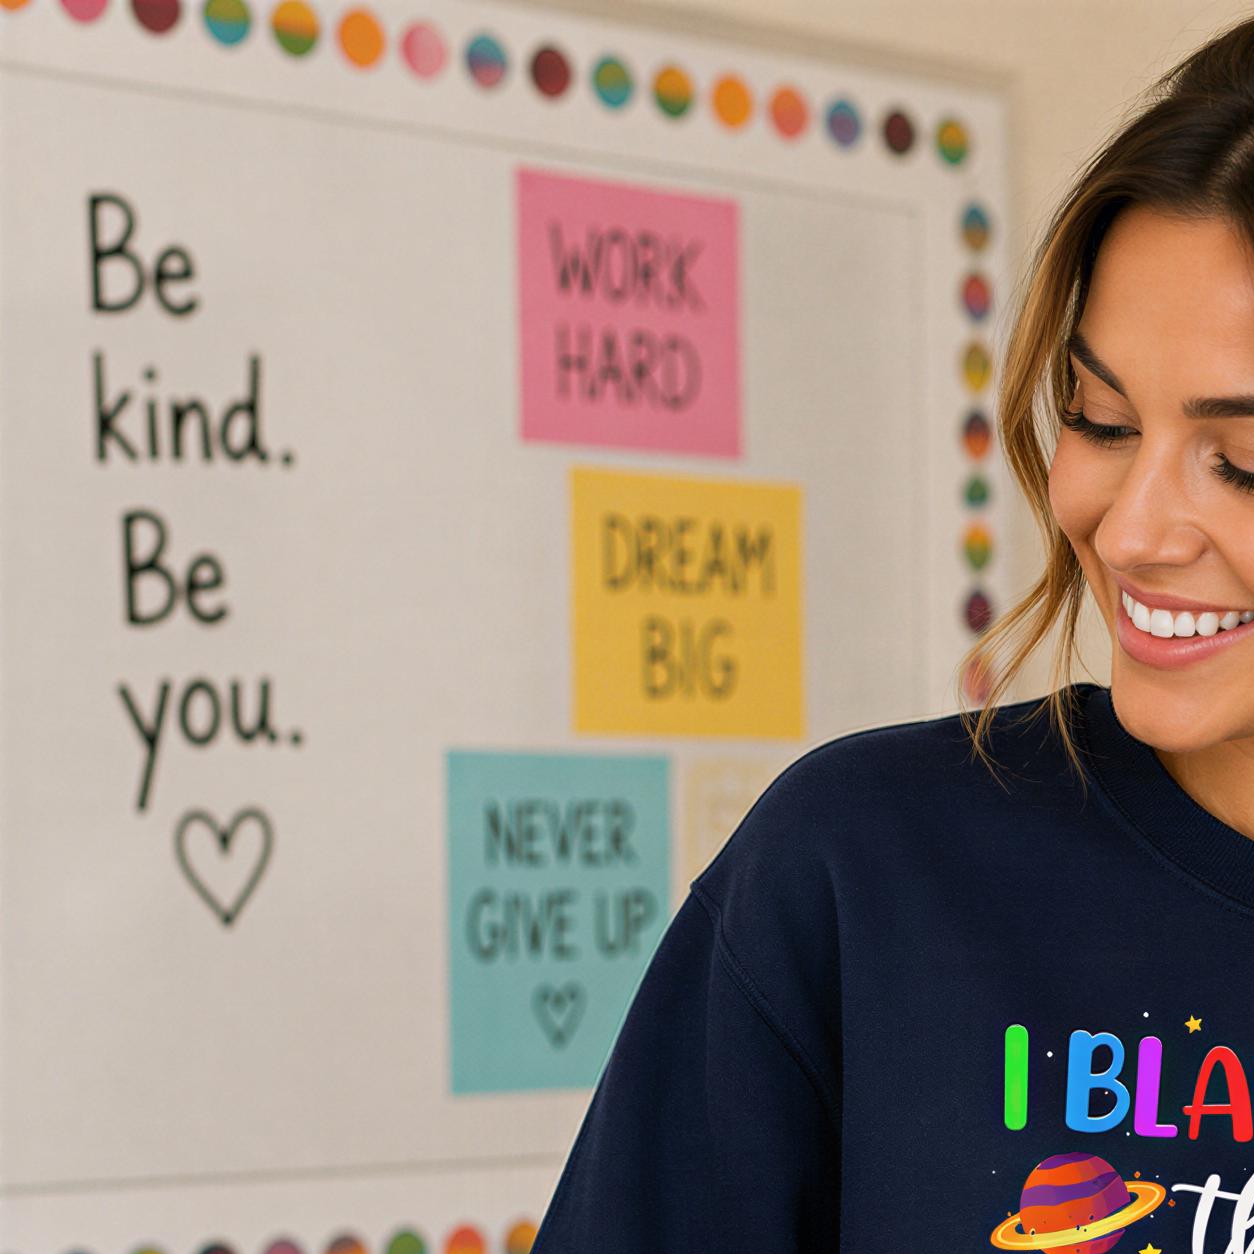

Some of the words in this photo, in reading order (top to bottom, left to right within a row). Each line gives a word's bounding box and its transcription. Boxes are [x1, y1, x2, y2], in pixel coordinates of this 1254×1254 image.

[88, 191, 200, 316] Be
[546, 218, 705, 315] WORK
[91, 349, 295, 467] kind.
[554, 323, 702, 413] HARD
[121, 509, 231, 627] Be
[602, 514, 777, 595] DREAM
[641, 614, 738, 704] BIG
[117, 677, 304, 811] you.
[484, 798, 638, 869] NEVER
[465, 887, 579, 965] GIVE
[594, 886, 659, 960] UP
[1003, 1023, 1029, 1132] I
